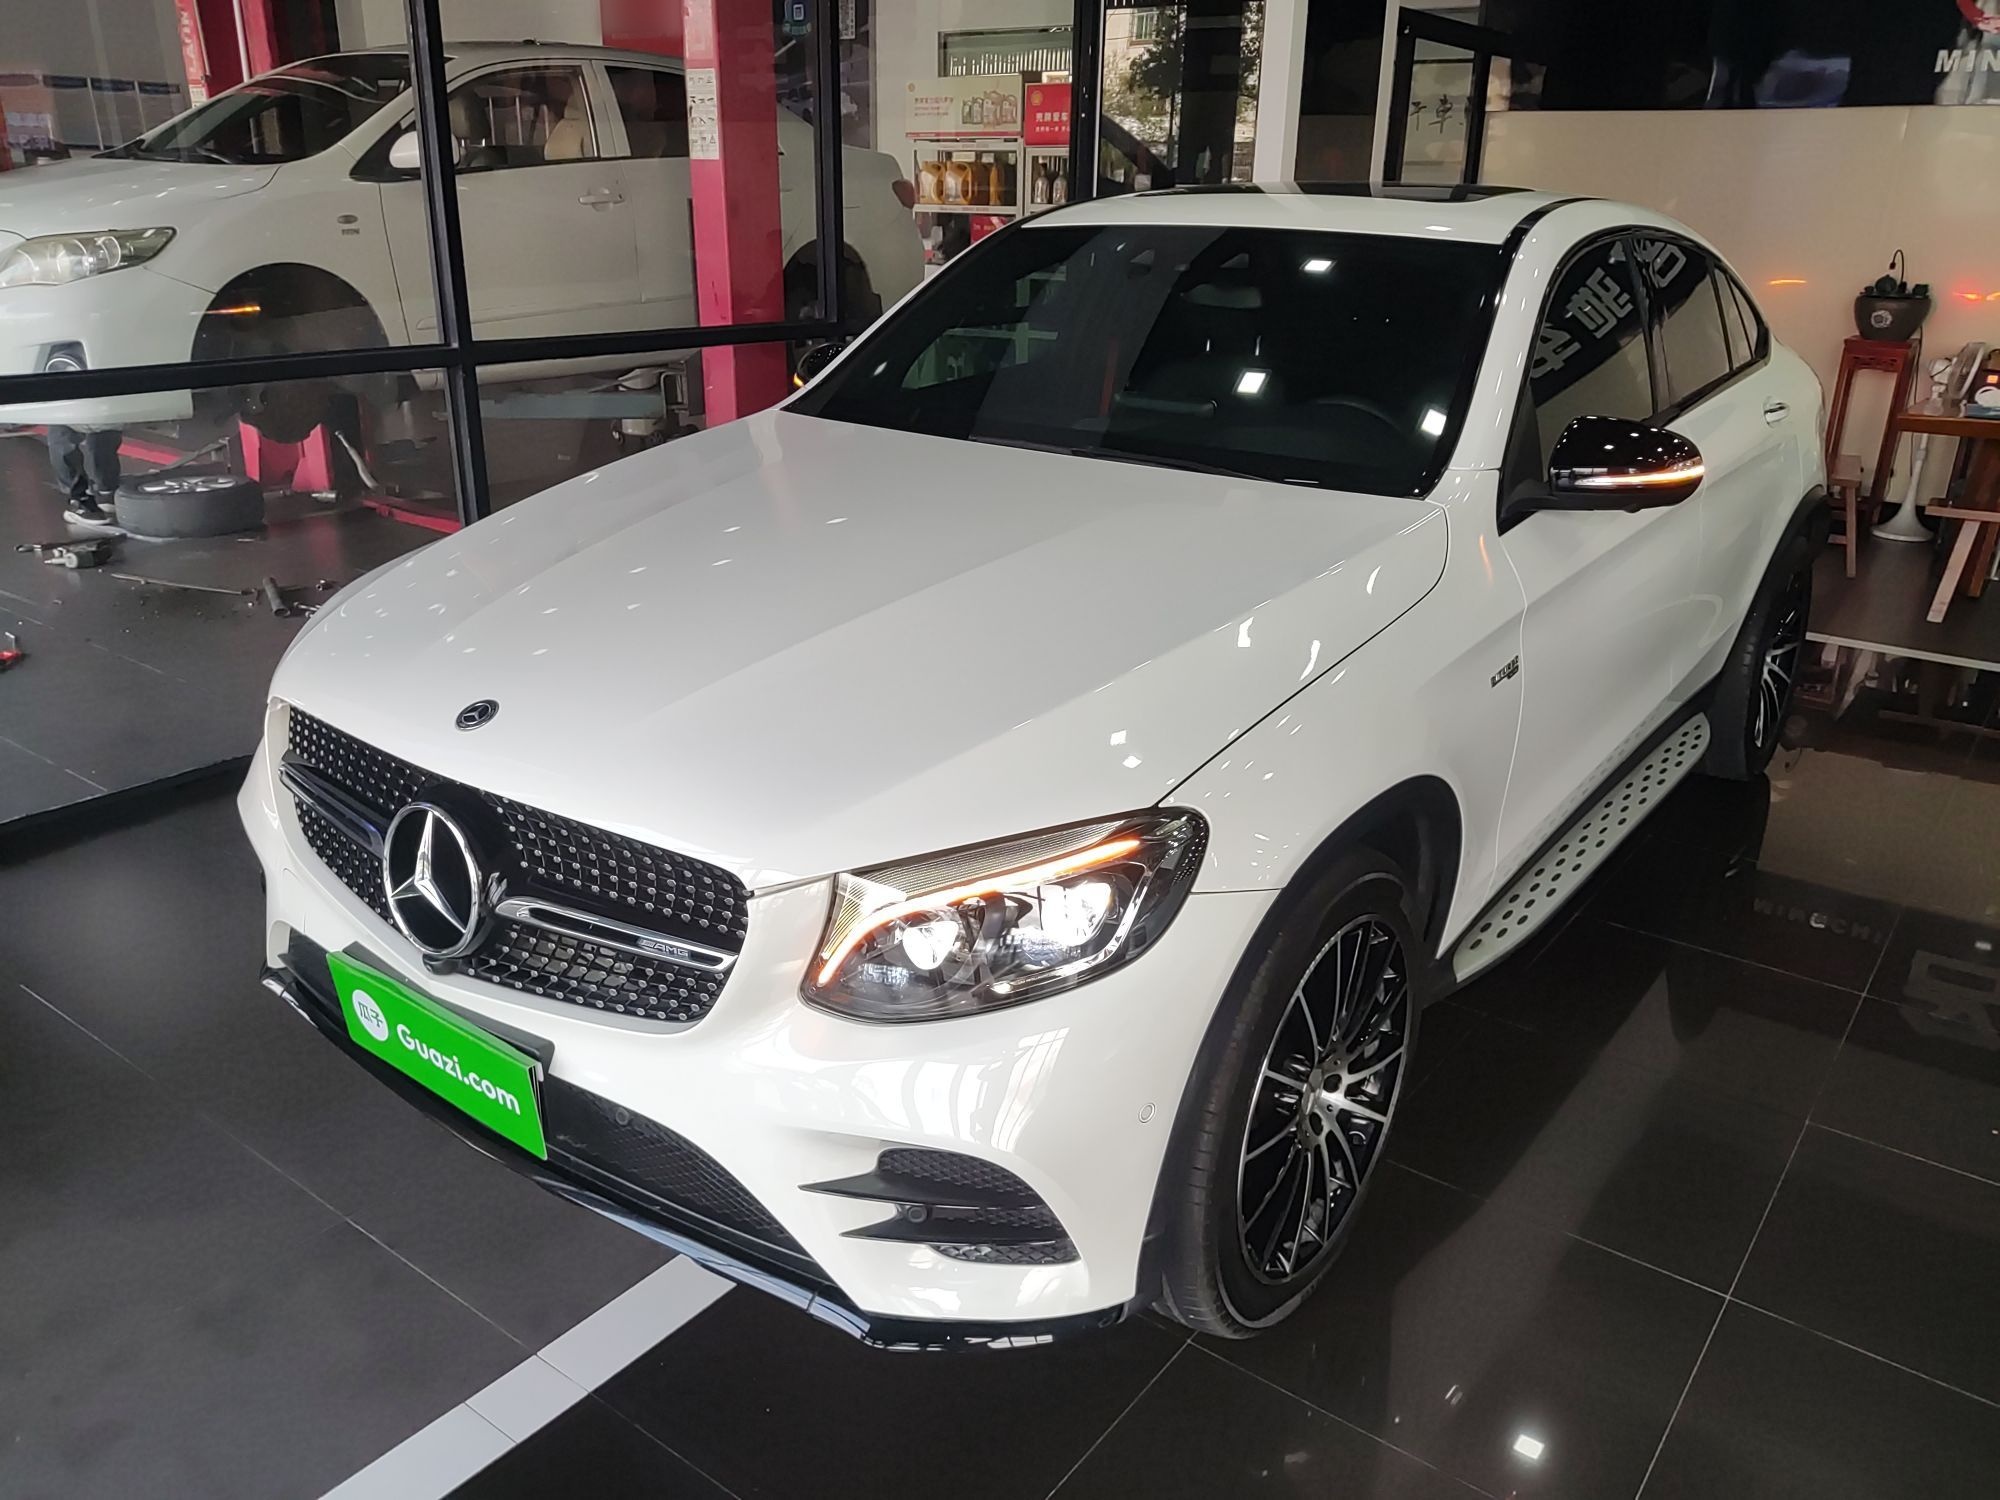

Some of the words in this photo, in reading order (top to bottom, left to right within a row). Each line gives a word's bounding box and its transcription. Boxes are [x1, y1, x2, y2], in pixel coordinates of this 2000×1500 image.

[1934, 49, 2000, 72] MIN
[654, 943, 688, 957] AMG
[396, 1023, 521, 1116] Guazi.com
